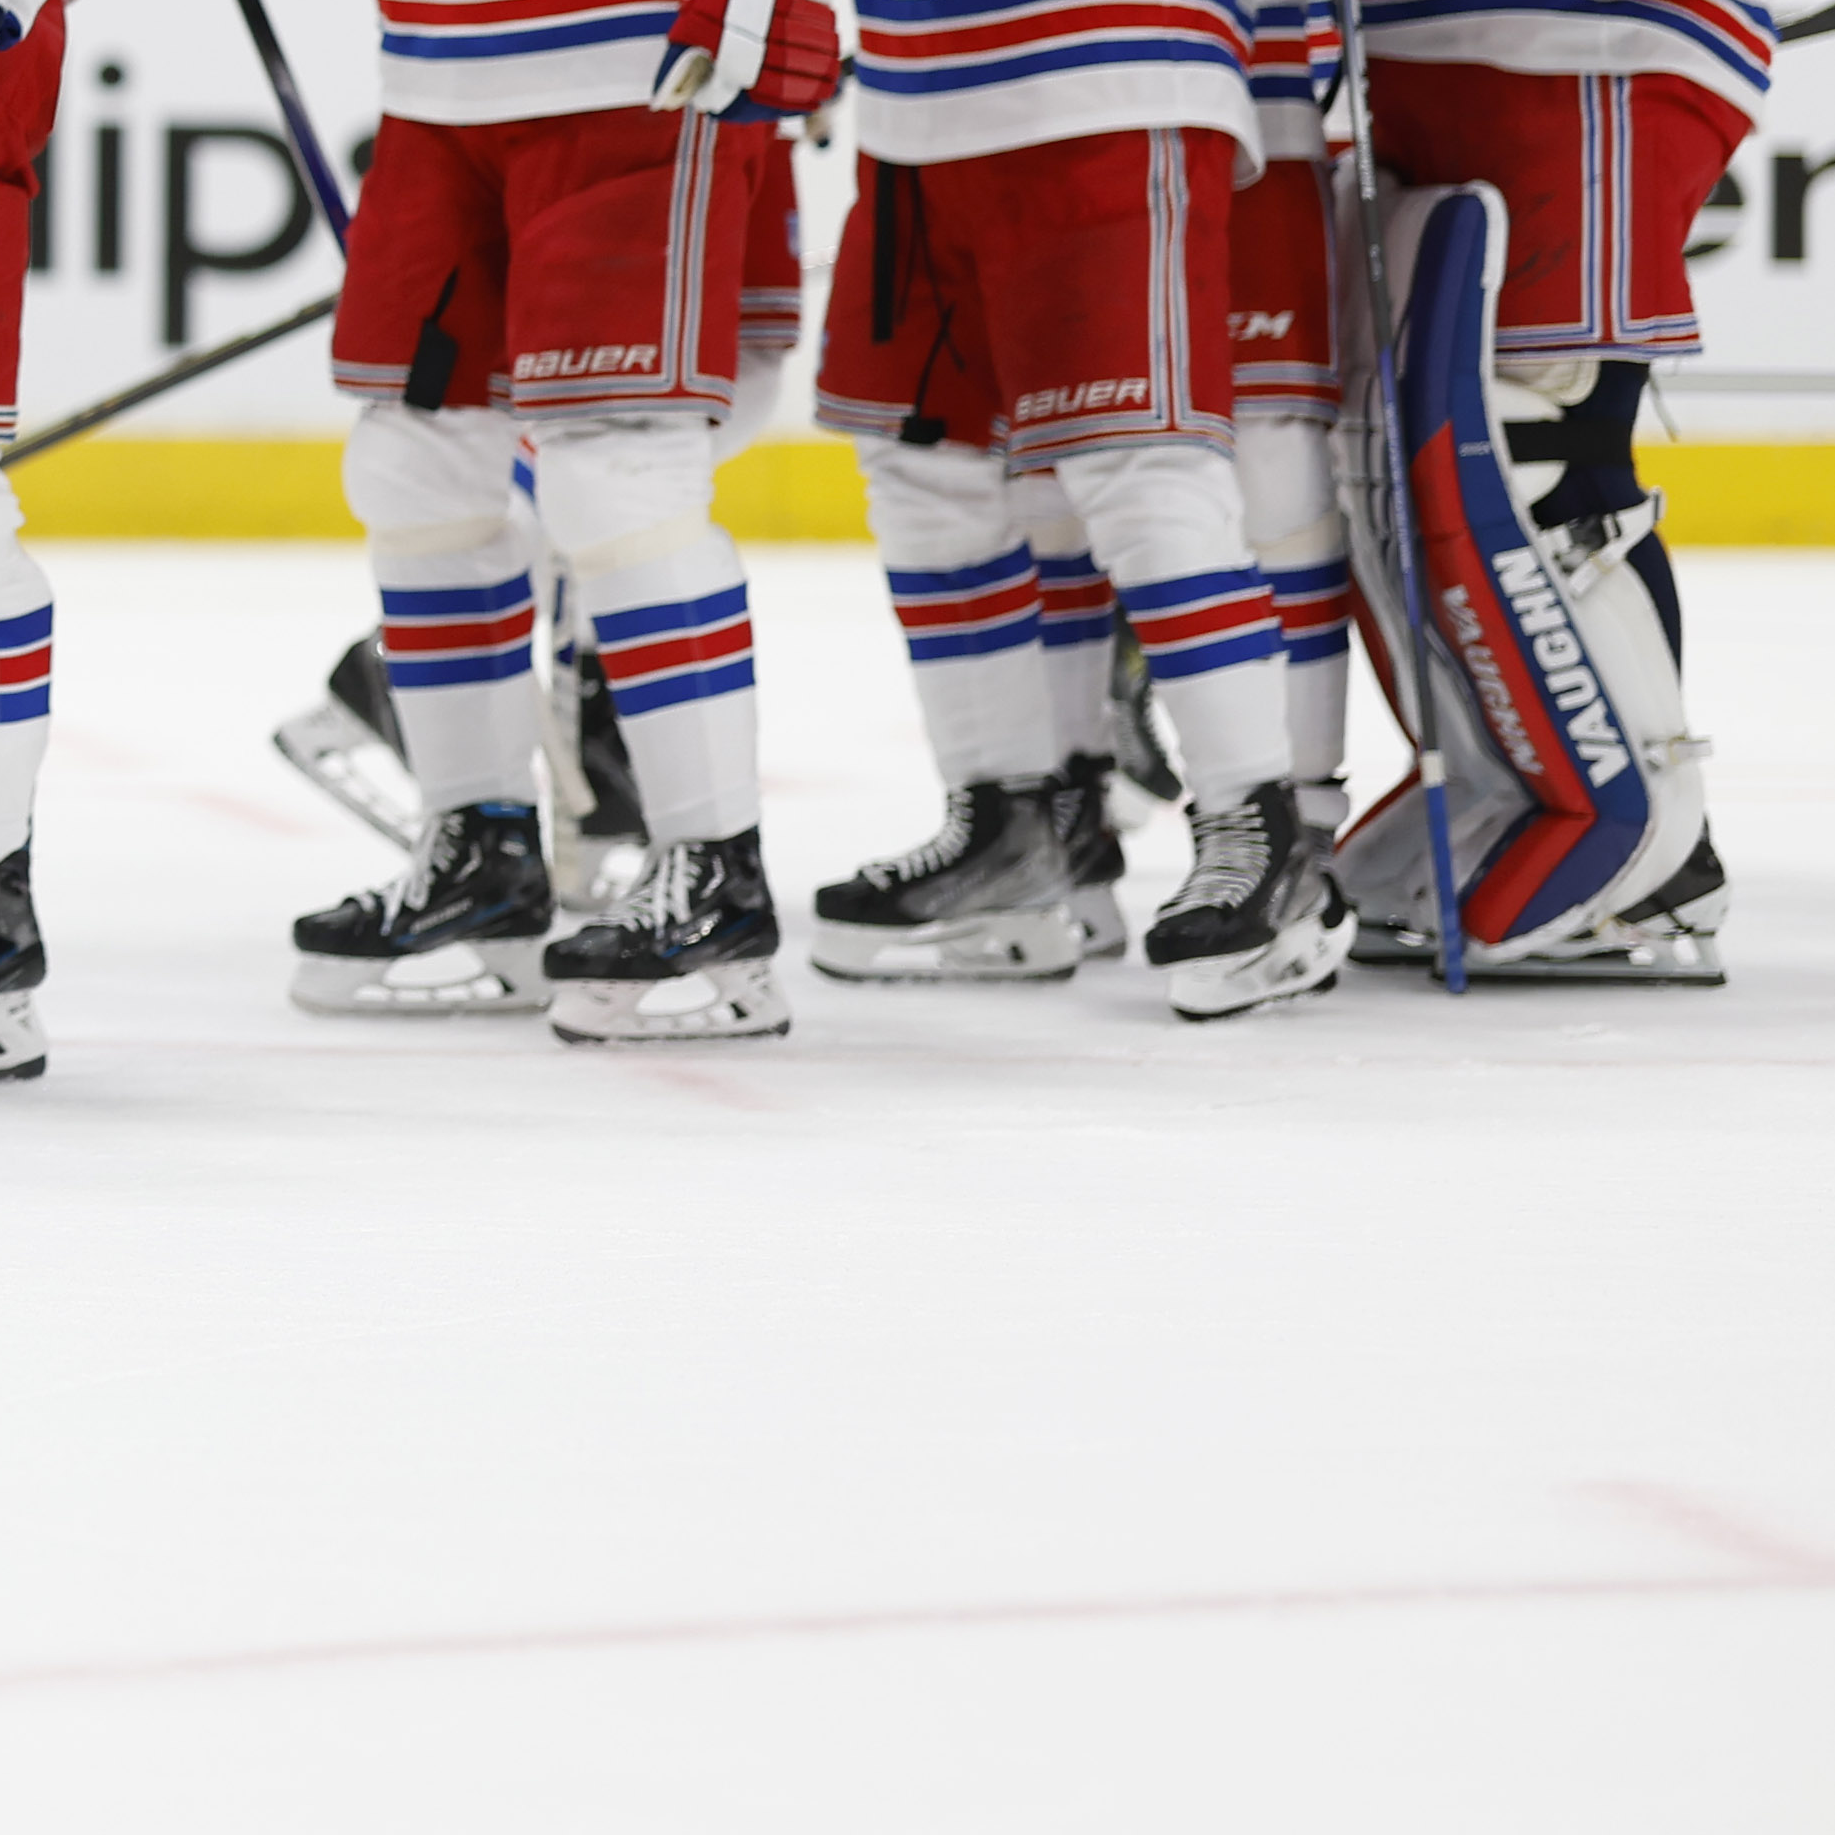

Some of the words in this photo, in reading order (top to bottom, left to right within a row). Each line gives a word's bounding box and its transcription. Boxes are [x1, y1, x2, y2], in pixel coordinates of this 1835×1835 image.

[514, 343, 659, 380] BAUER
[1015, 375, 1151, 422] BAUER
[1492, 545, 1631, 789] VAUGHN
